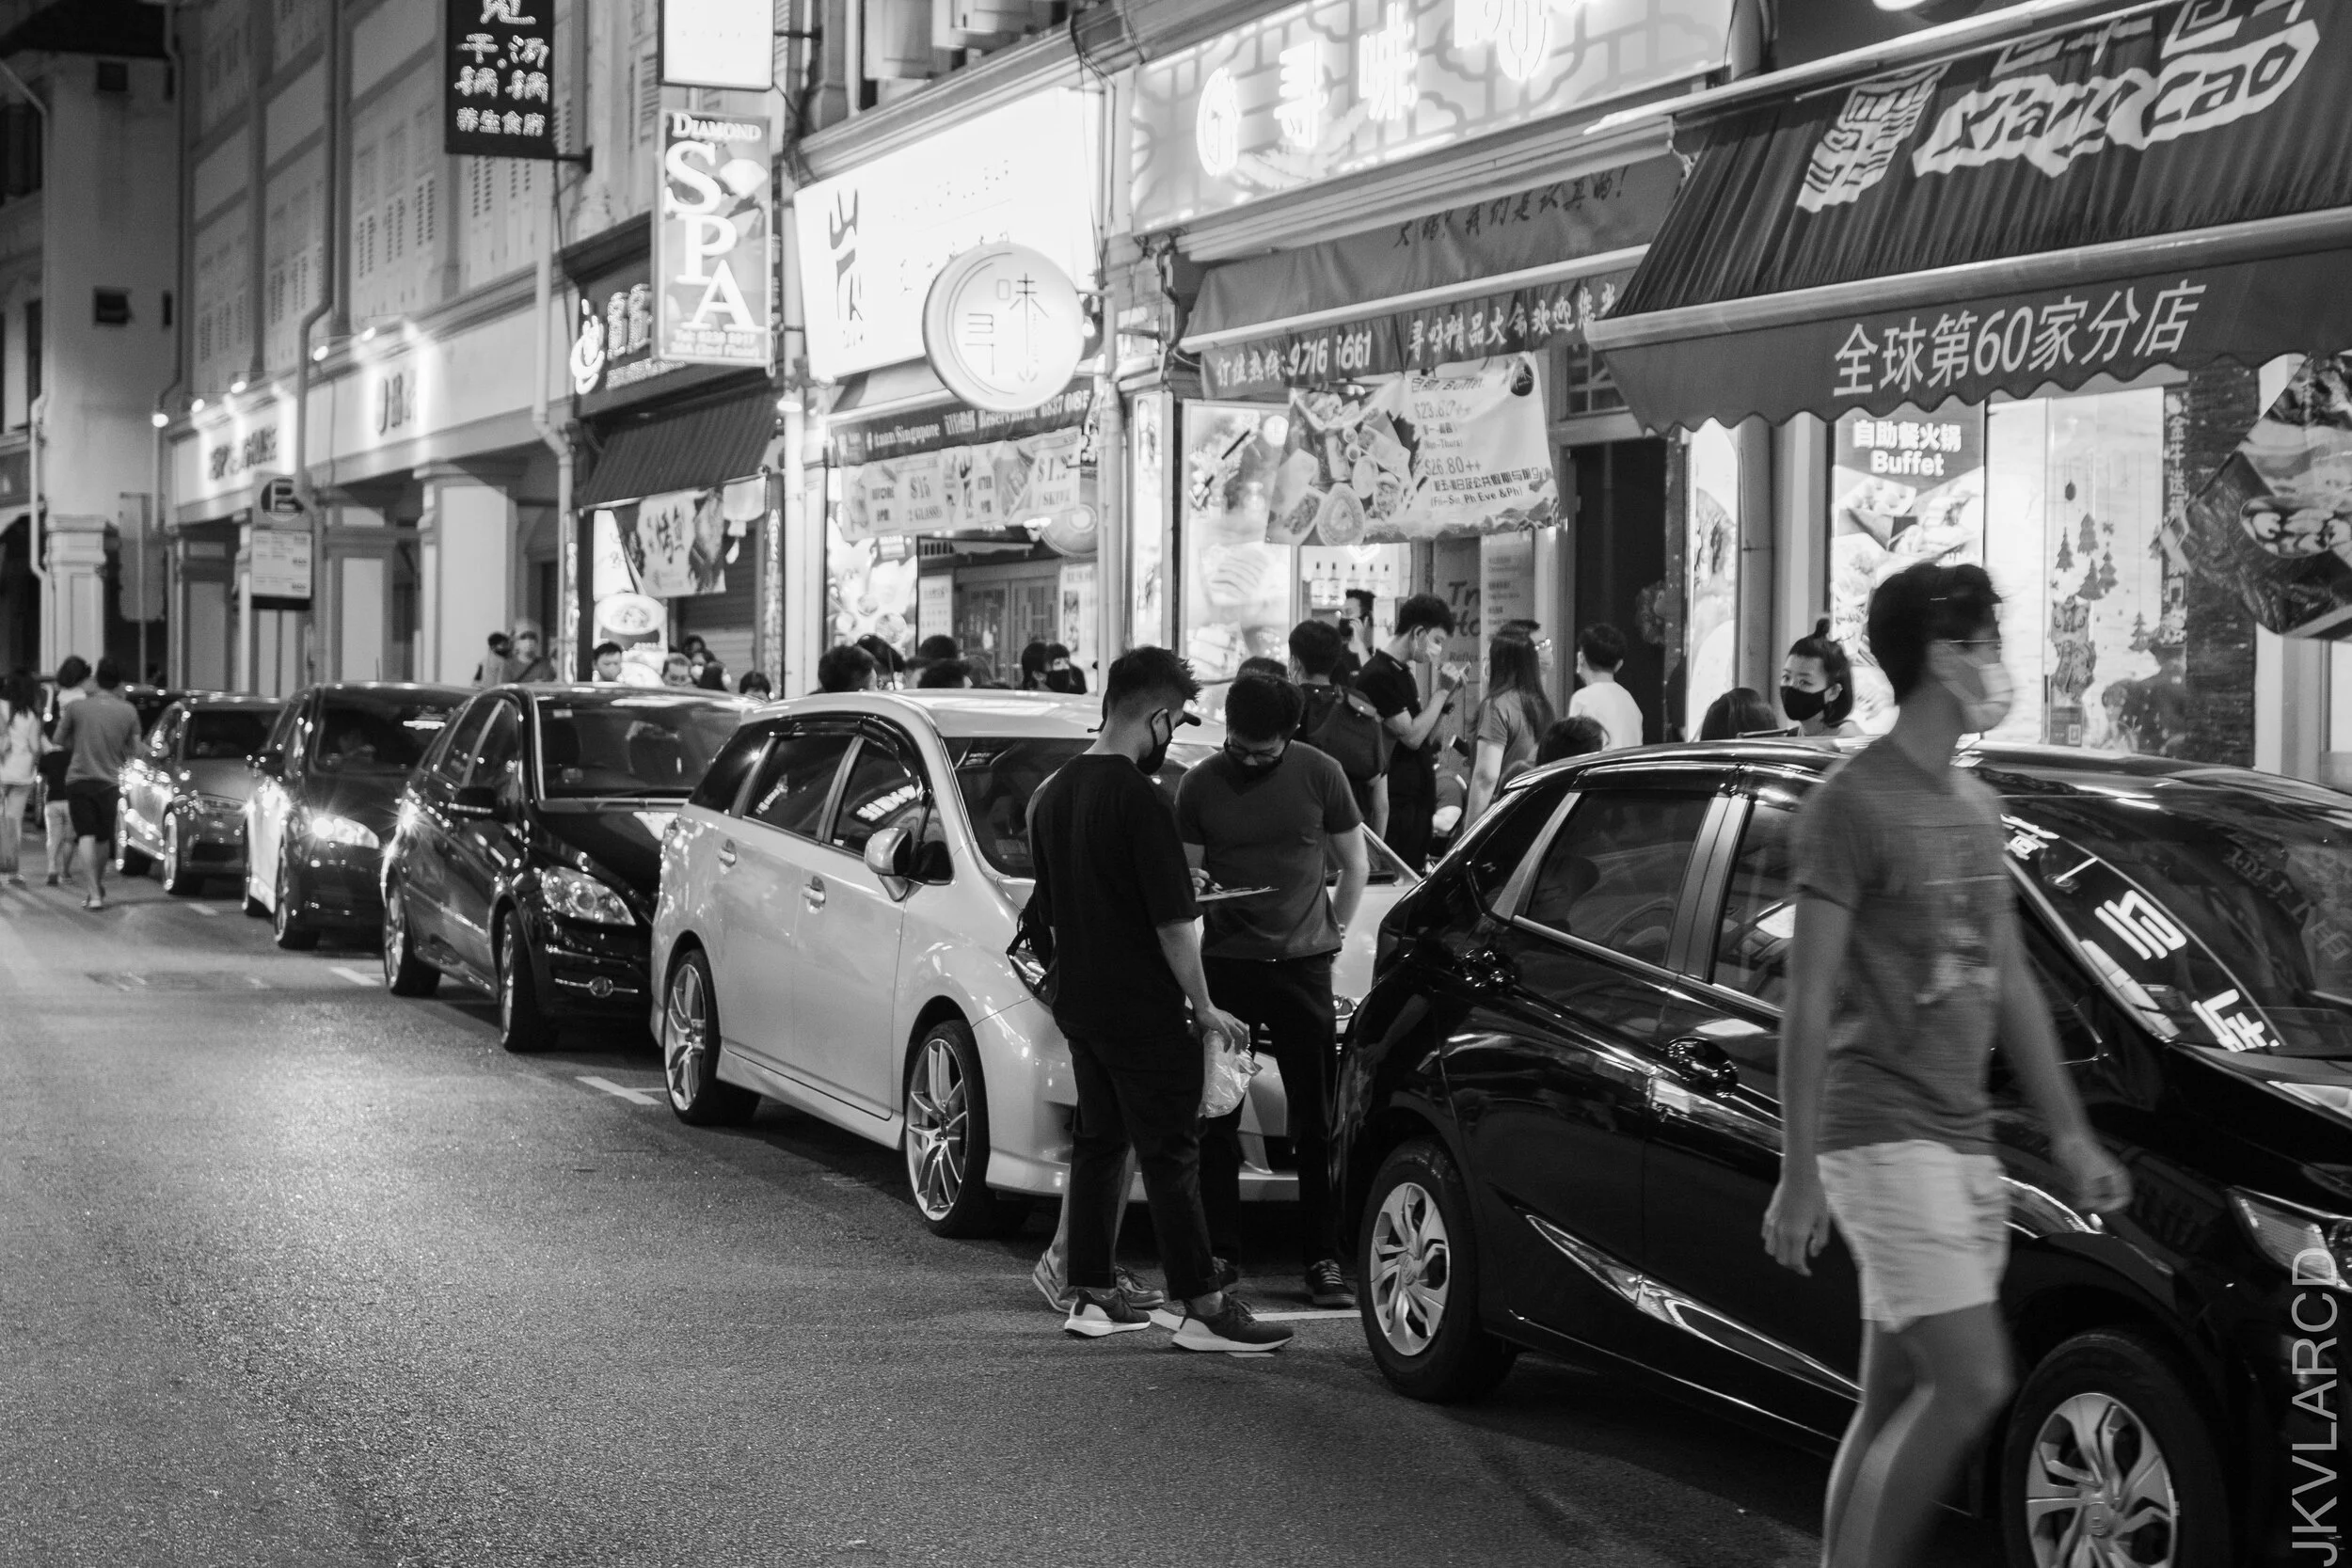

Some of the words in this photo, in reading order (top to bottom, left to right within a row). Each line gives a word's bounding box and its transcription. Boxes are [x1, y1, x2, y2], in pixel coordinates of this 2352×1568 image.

[662, 140, 768, 331] SPA
[1834, 280, 2207, 396] 全球第60家分店
[894, 423, 940, 445] Singapore
[1870, 450, 1945, 476] Buffet
